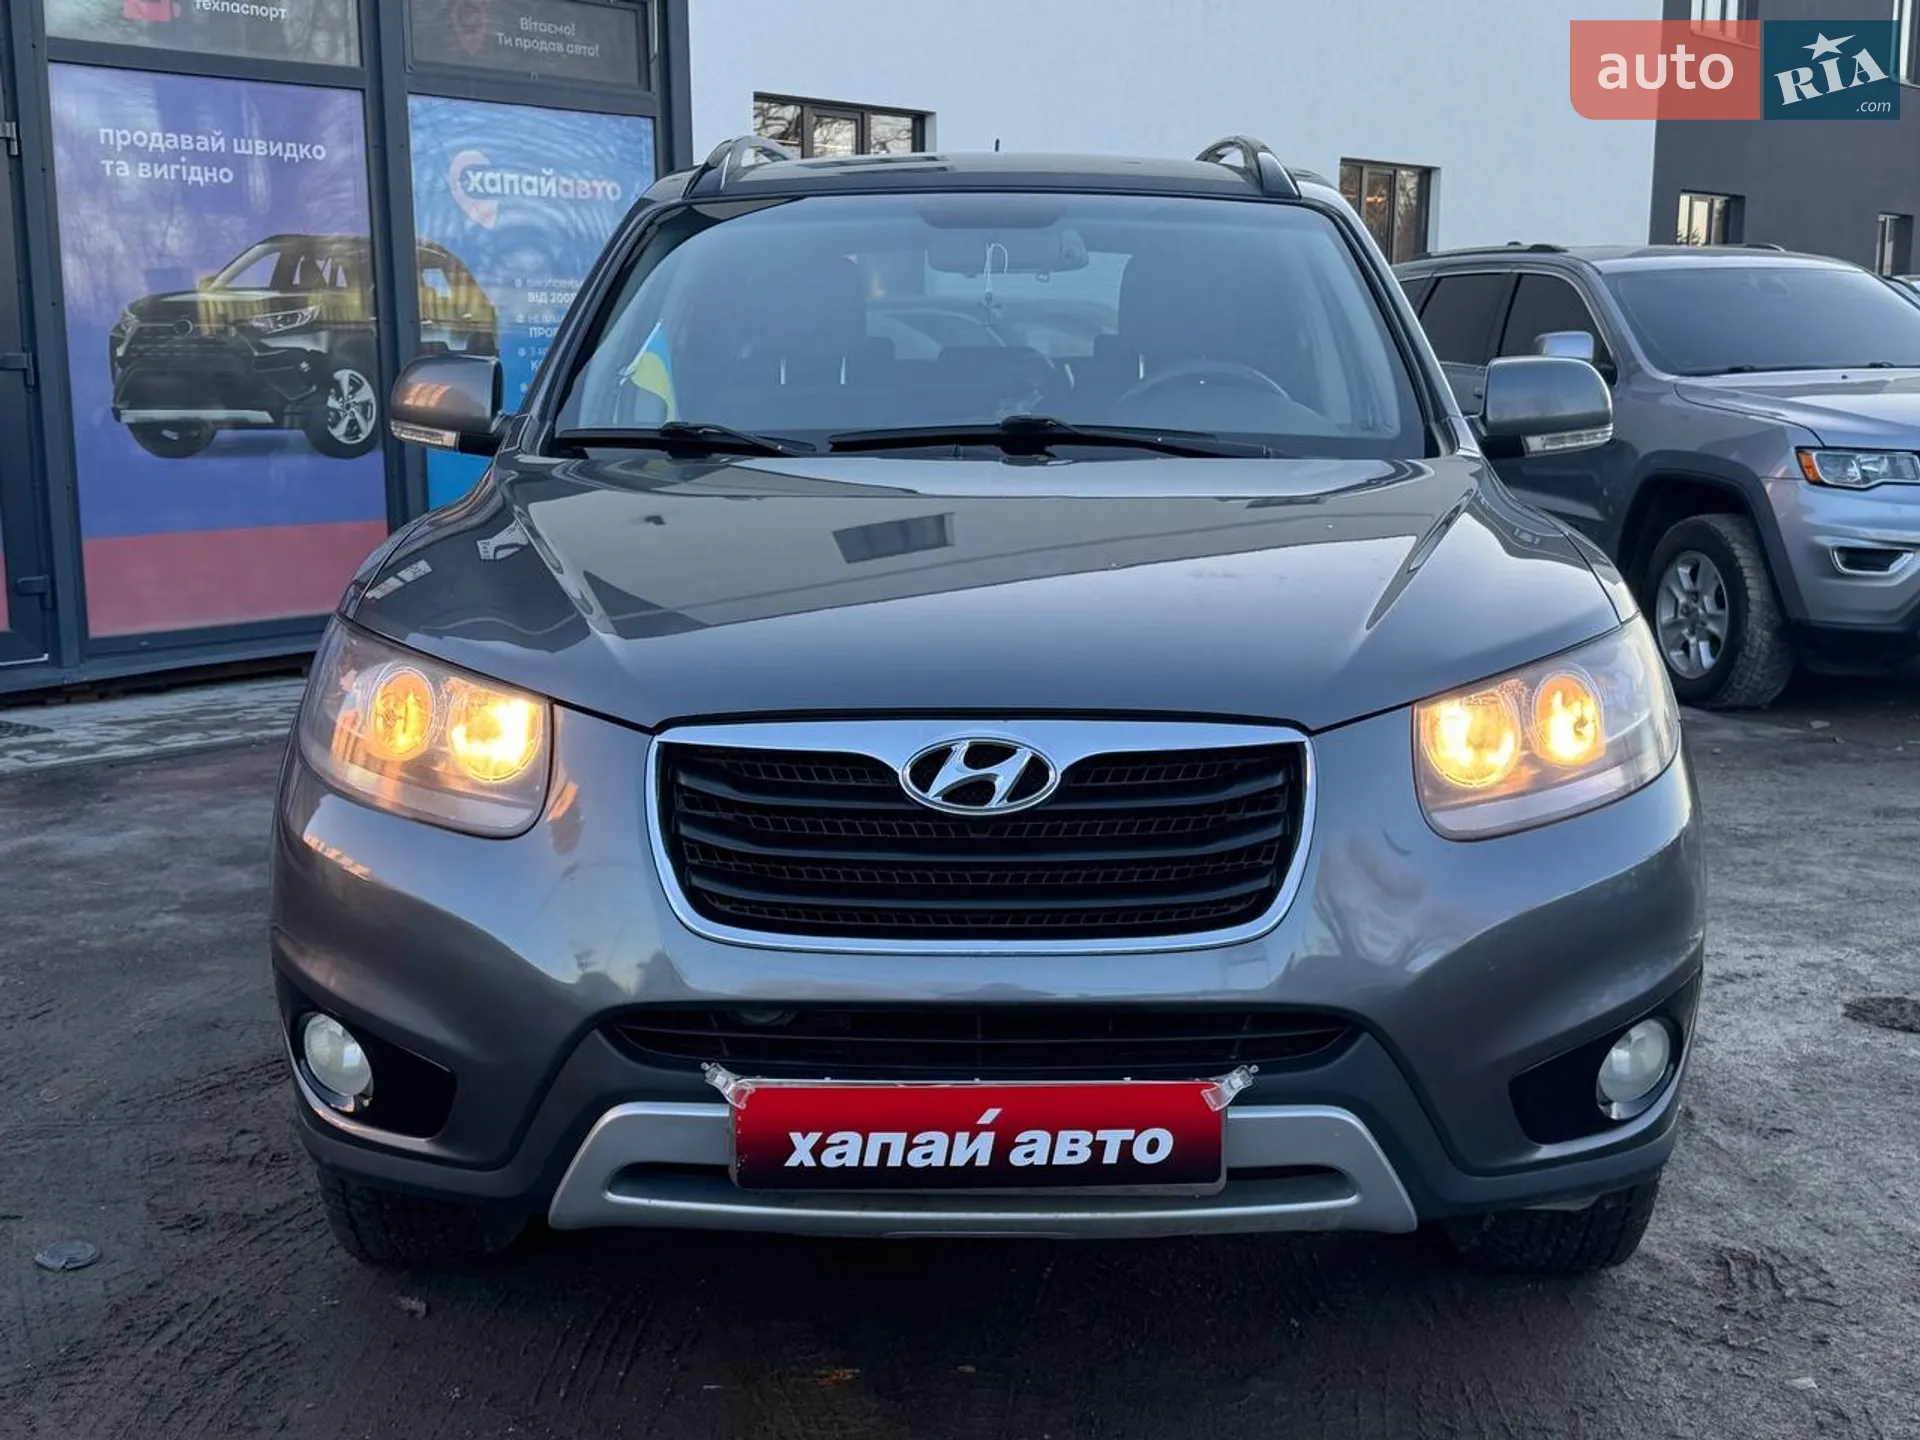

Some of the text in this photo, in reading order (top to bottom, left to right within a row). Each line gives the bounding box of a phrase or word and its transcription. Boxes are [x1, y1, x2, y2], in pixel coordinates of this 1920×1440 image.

[520, 16, 576, 36] Вітаємо!
[496, 32, 600, 57] Ти продав авто!
[98, 127, 327, 163] продавай швидко
[101, 156, 234, 187] та вигідно
[1008, 1127, 1174, 1166] авто
